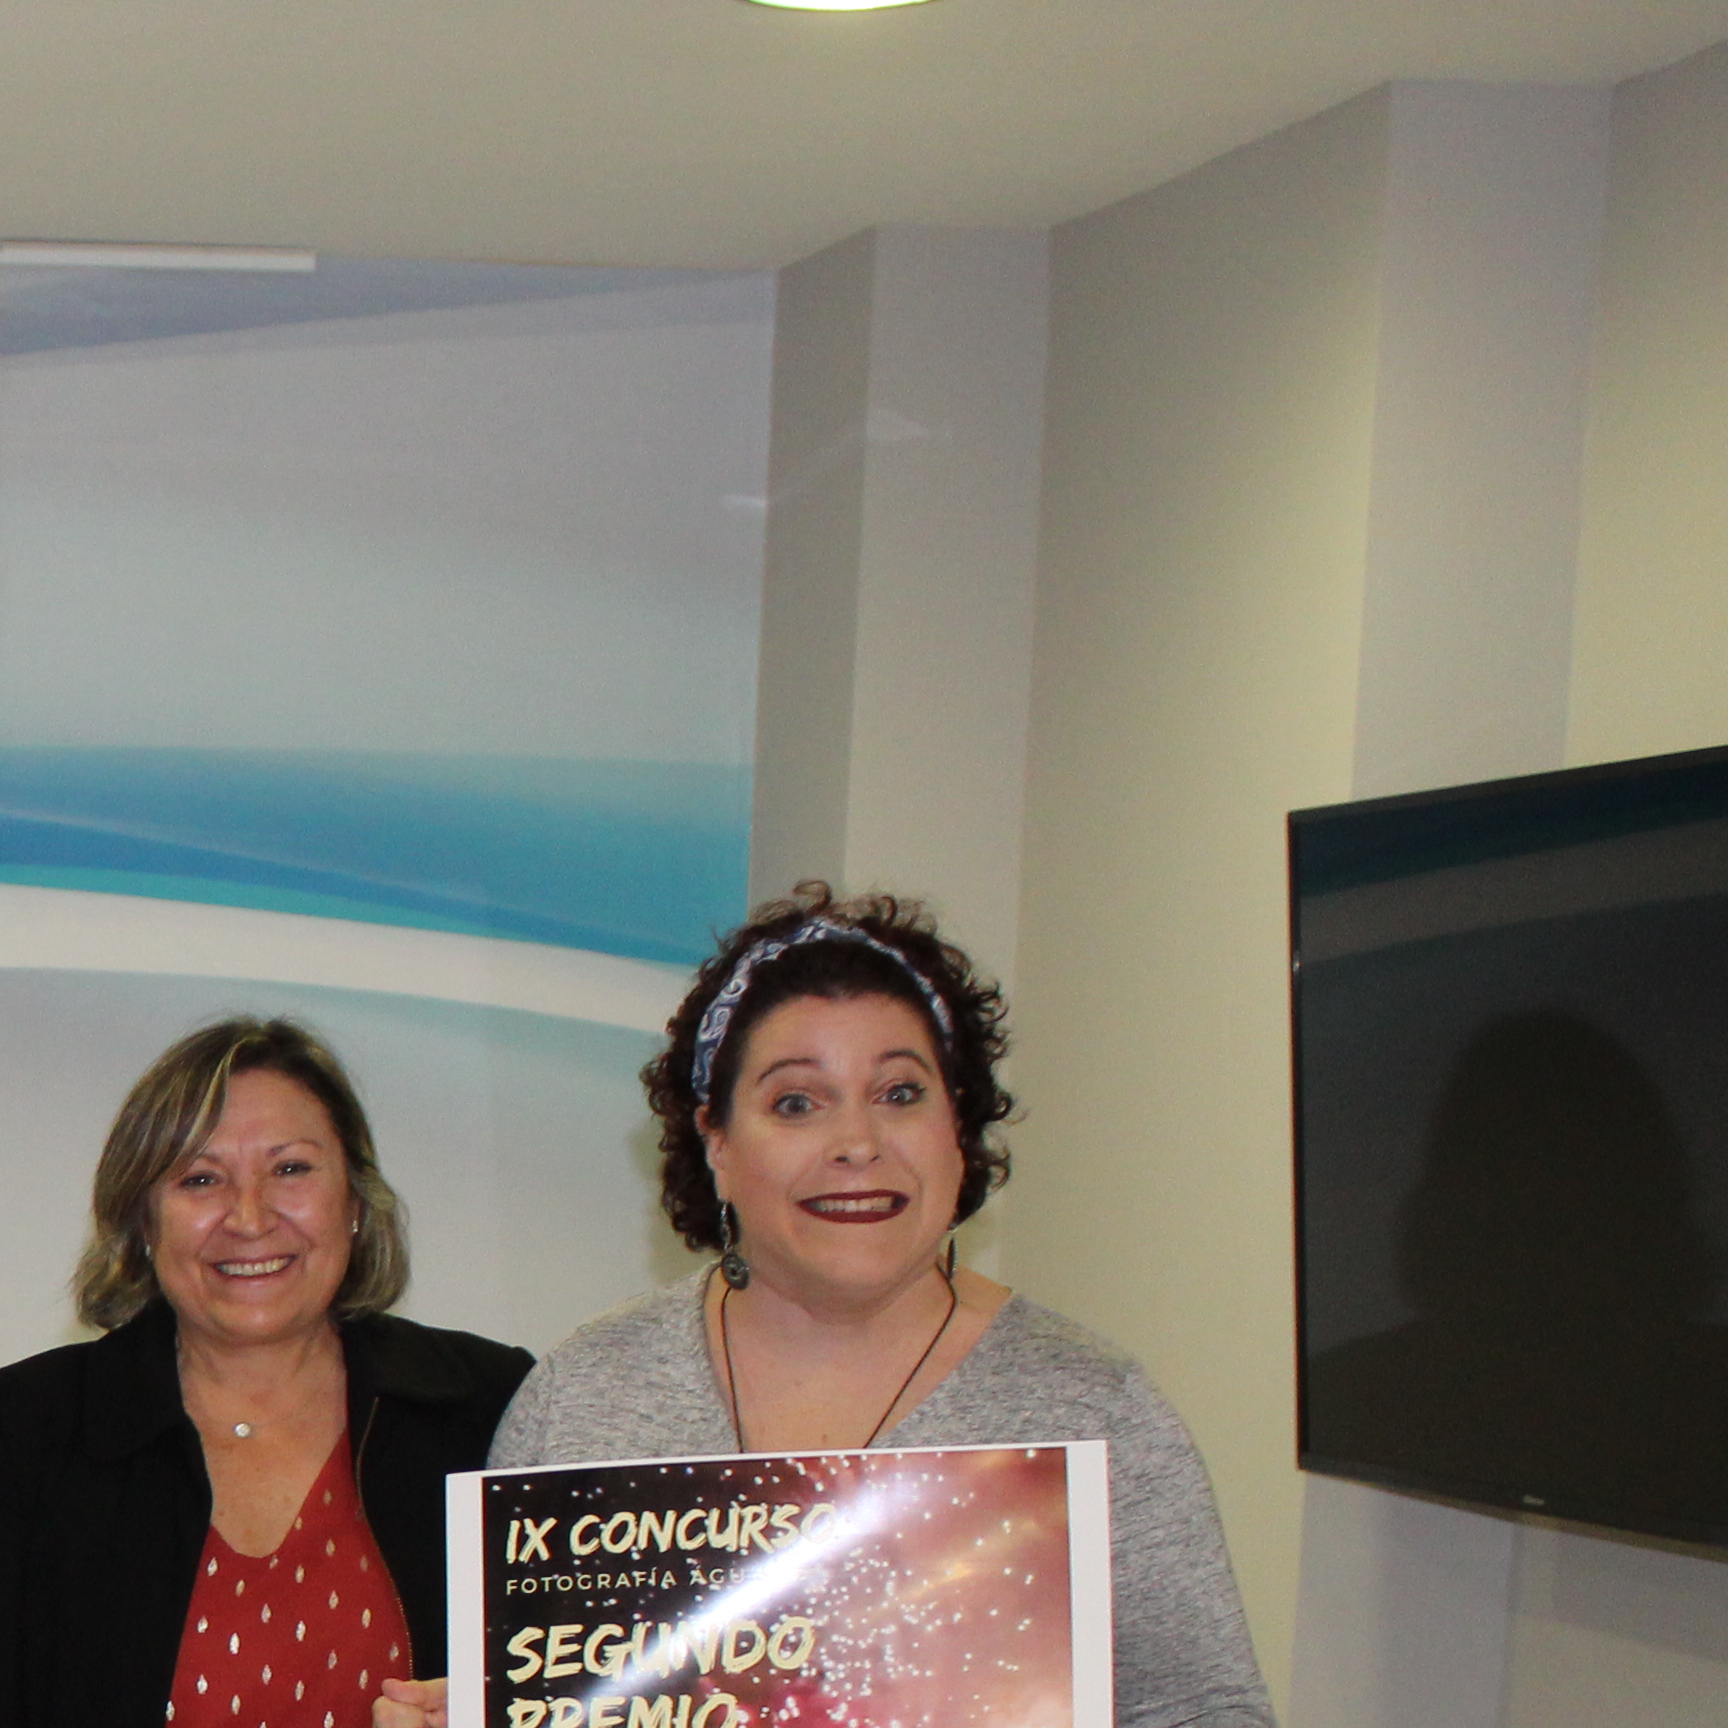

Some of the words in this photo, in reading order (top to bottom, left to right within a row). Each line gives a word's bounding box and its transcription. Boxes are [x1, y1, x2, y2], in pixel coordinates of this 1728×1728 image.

[505, 1517, 558, 1564] IX
[569, 1502, 837, 1556] CONCURSO
[505, 1566, 678, 1596] FOTOGRAFÍA
[505, 1615, 817, 1685] SEGUNDO
